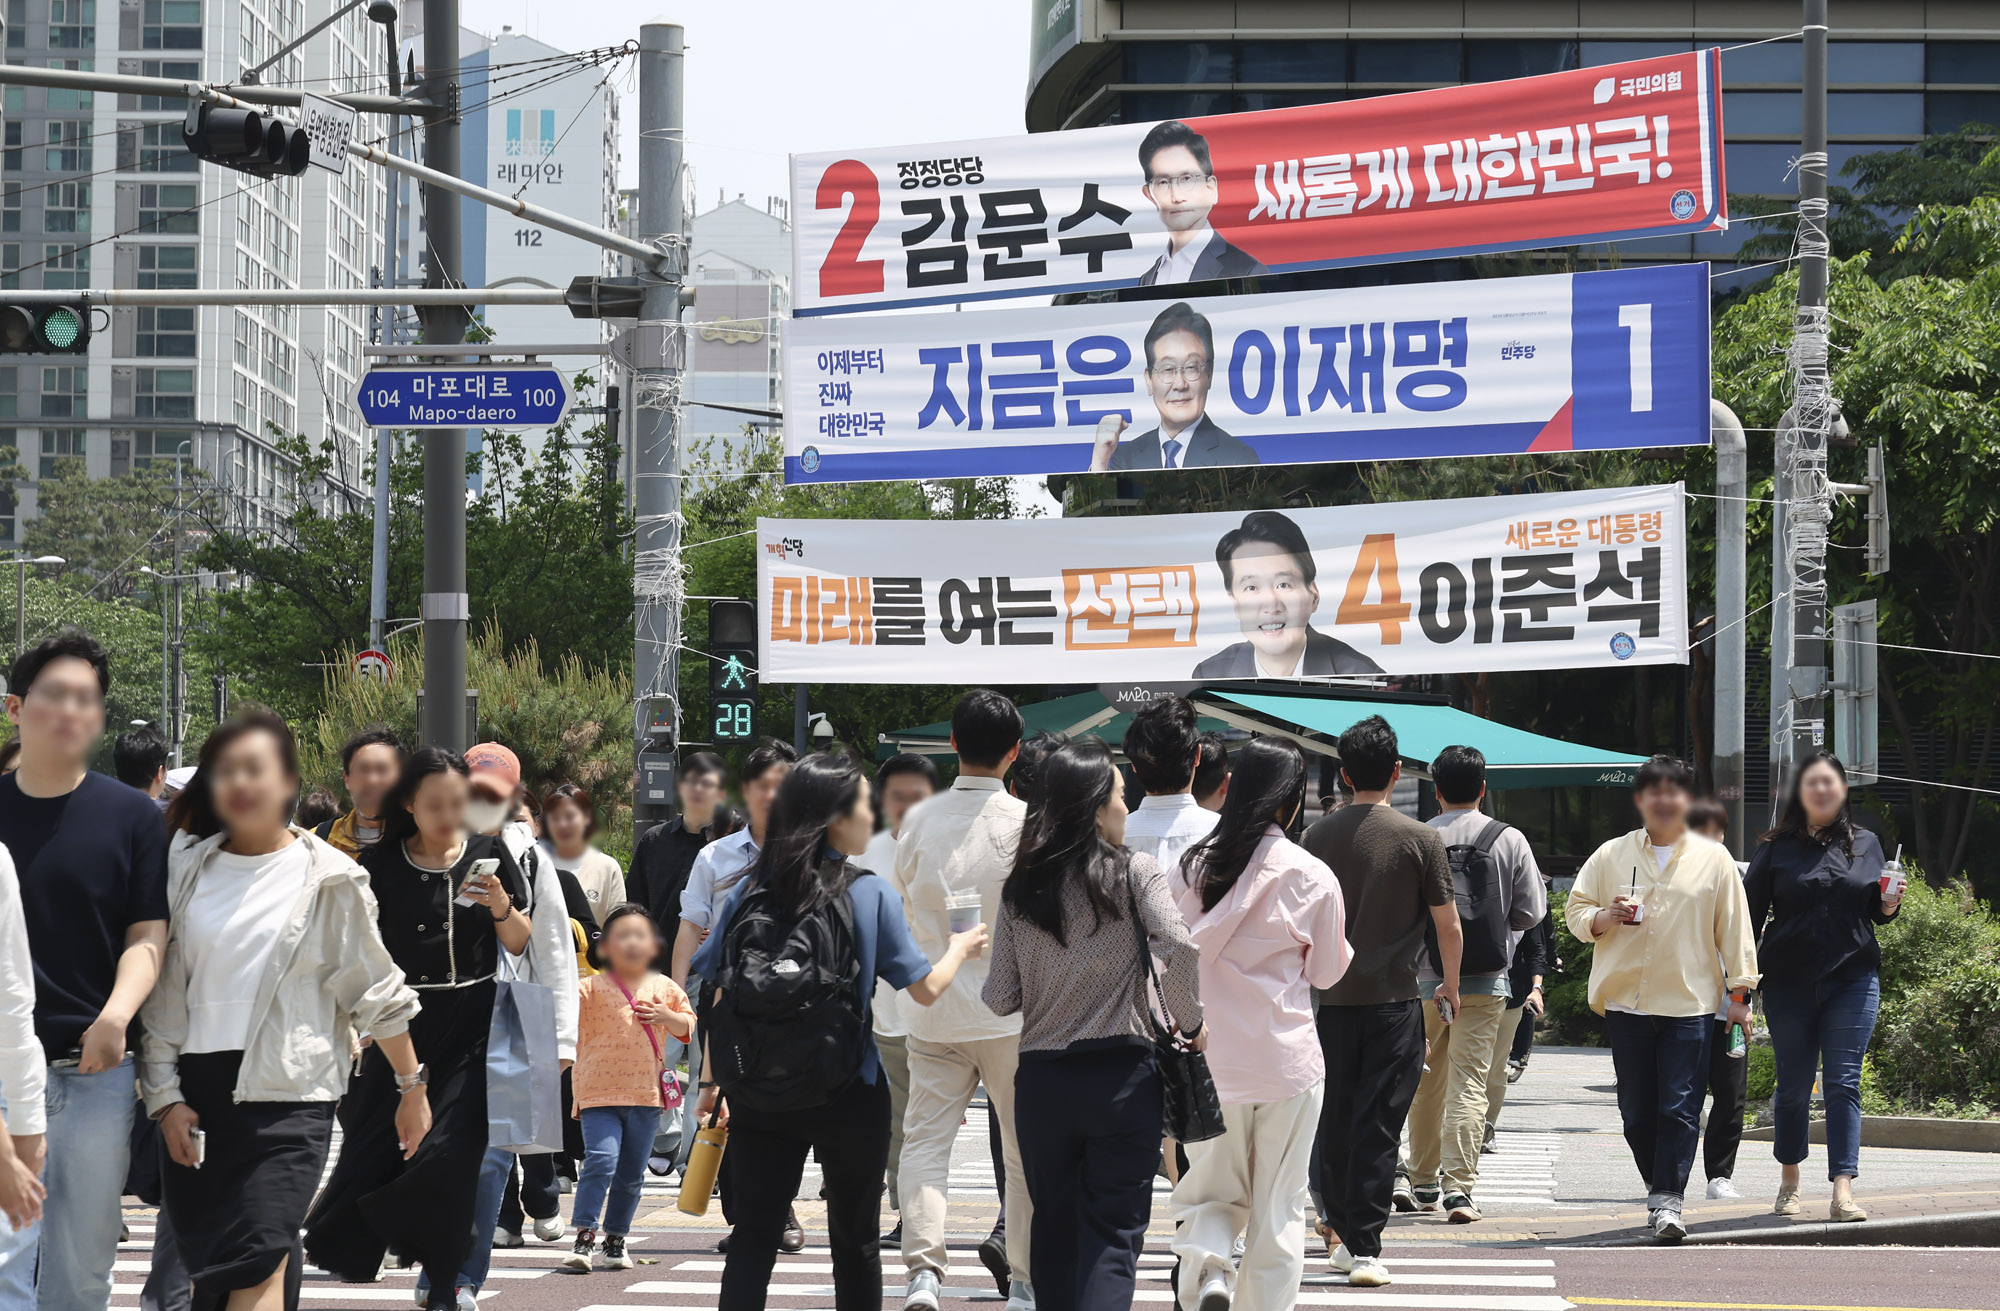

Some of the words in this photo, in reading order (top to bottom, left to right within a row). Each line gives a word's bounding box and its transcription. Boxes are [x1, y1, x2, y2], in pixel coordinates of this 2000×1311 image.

[1620, 71, 1682, 97] 국민의힘
[497, 163, 564, 184] 래미안
[897, 156, 985, 190] 정정당당
[1248, 146, 1416, 221] 새롭게
[1422, 114, 1672, 203] 대한민국!
[514, 229, 542, 247] 112
[815, 159, 885, 298] 2
[900, 182, 1133, 289] 김문수
[817, 348, 884, 376] 이제부터
[1501, 345, 1536, 361] 민주당
[1618, 303, 1653, 413] 1
[917, 335, 1135, 431] 지금은
[1228, 316, 1469, 417] 이재명
[367, 389, 401, 408] 104
[413, 375, 512, 400] 마포대로
[523, 388, 556, 407] 100
[818, 381, 853, 407] 진짜
[409, 405, 517, 423] Mapo-daero
[819, 411, 886, 438] 대한민국
[1504, 517, 1581, 550] 새로운
[1586, 511, 1663, 545] 대통령
[765, 537, 804, 560] 개혁신당
[1334, 533, 1412, 645] 4
[1417, 546, 1662, 644] 이준석
[770, 575, 926, 646] 미래를
[938, 576, 1058, 646] 여는
[1066, 569, 1194, 645] 선택
[1116, 686, 1153, 702] MAPO
[716, 704, 751, 736] 28
